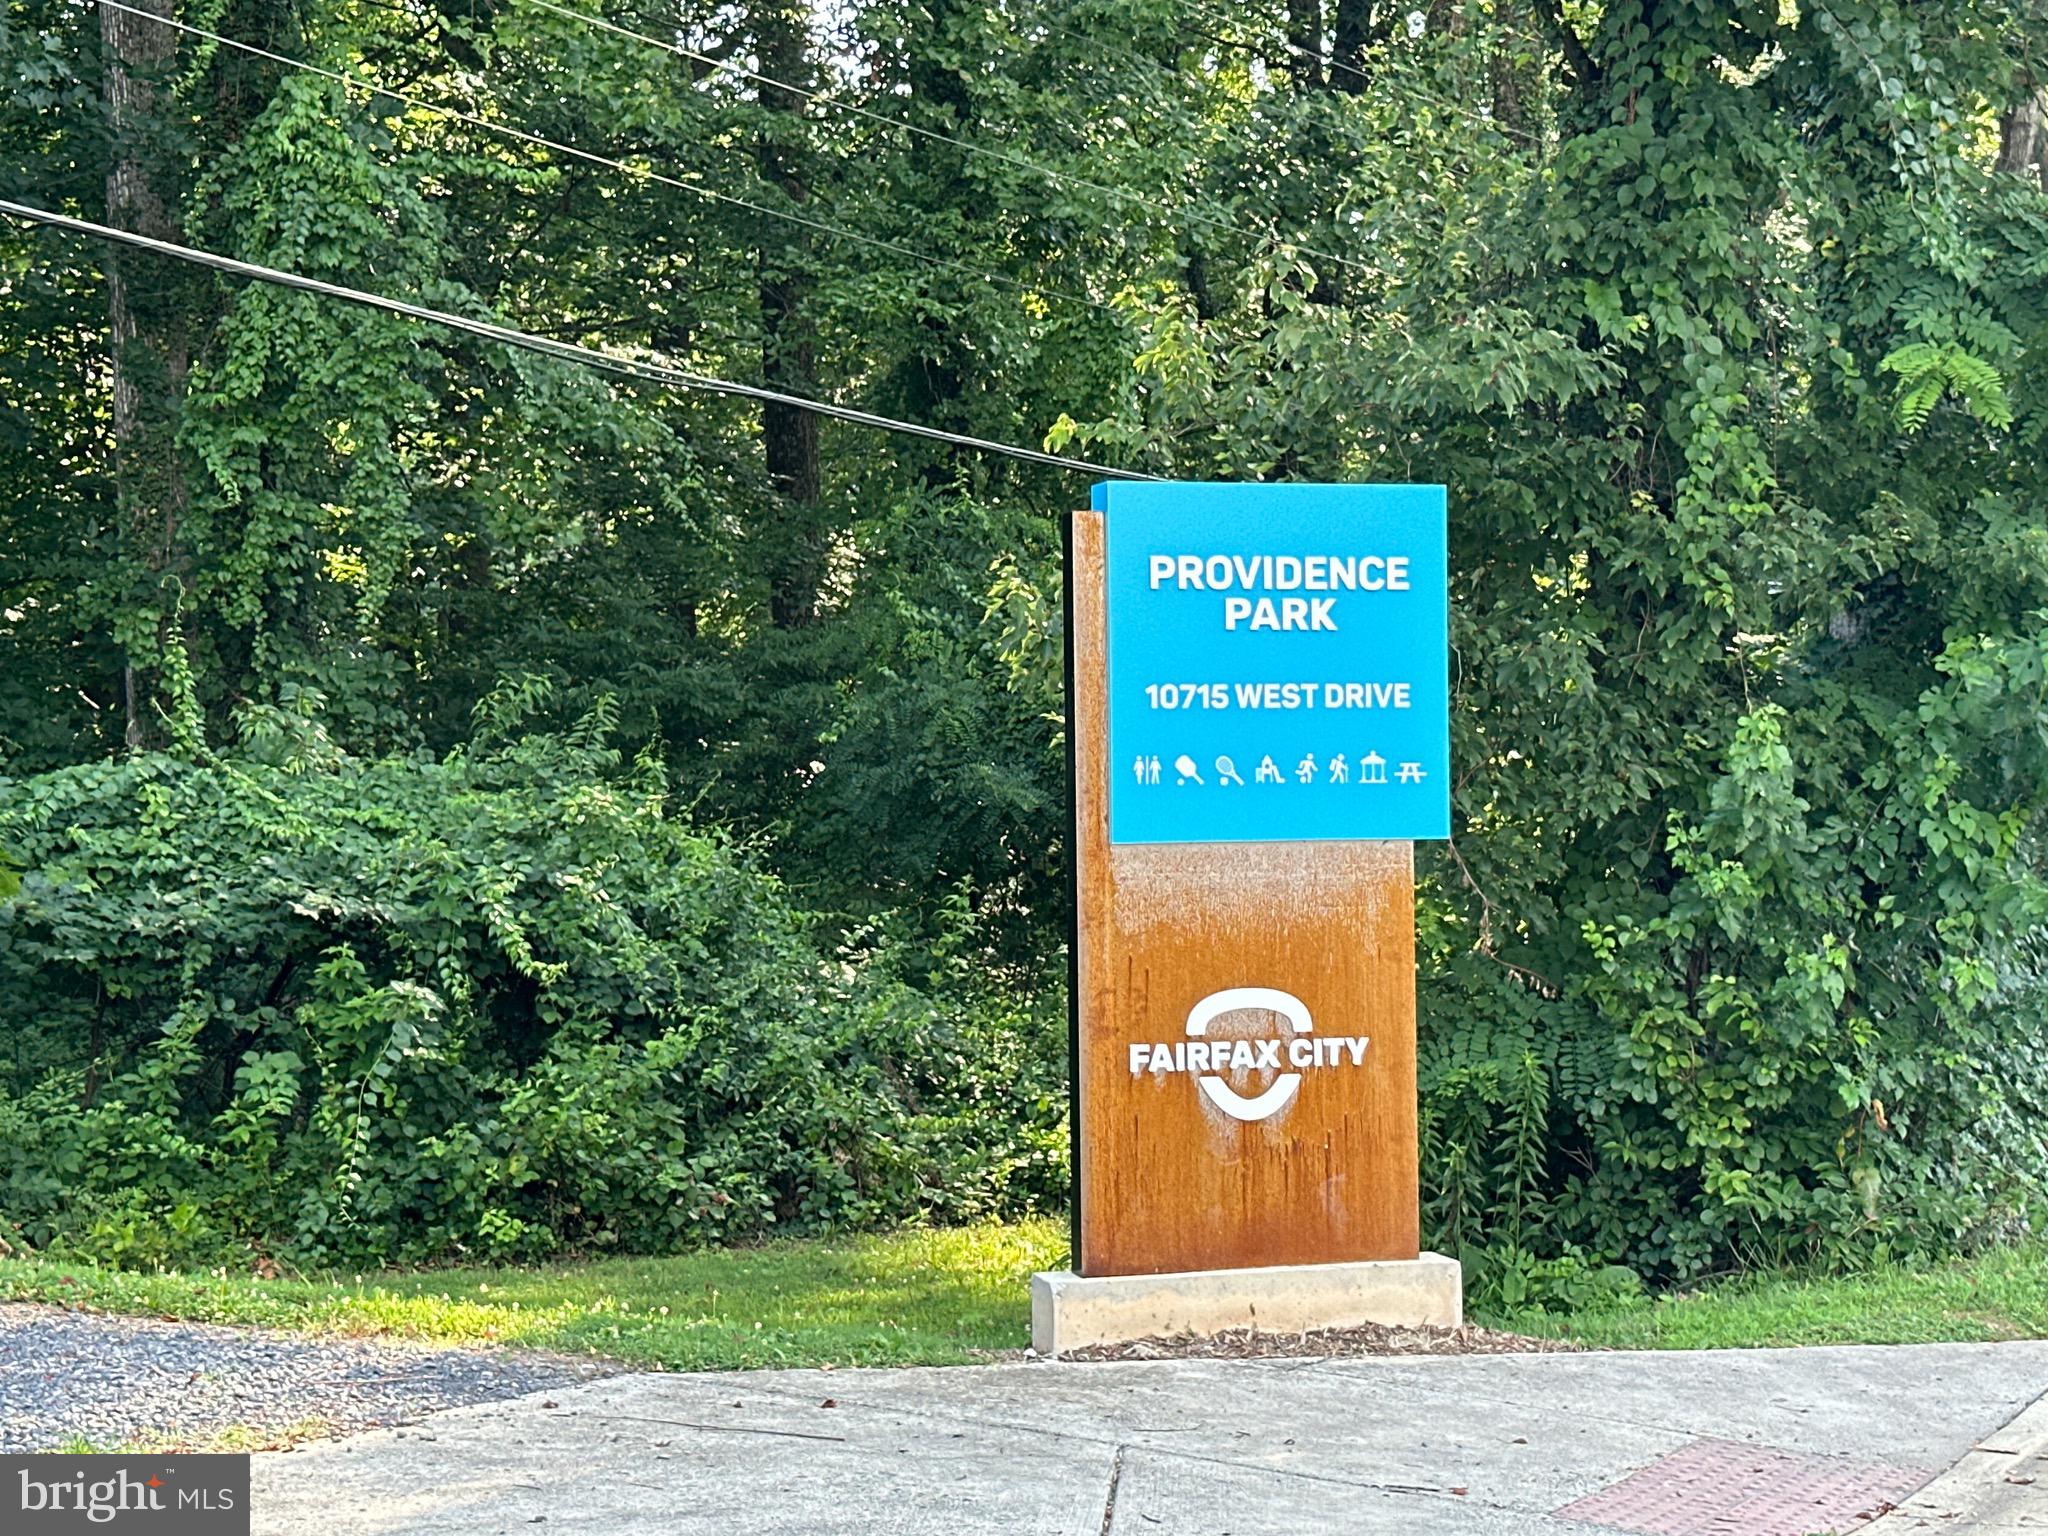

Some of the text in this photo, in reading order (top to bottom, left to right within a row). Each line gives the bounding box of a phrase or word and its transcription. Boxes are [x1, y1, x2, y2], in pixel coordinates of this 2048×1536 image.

[1149, 555, 1411, 591] PROVIDENCE
[1224, 597, 1339, 631] PARK
[1145, 682, 1412, 710] 10715 WEST DRIVE
[1129, 1036, 1370, 1073] FAIRFAX CITY
